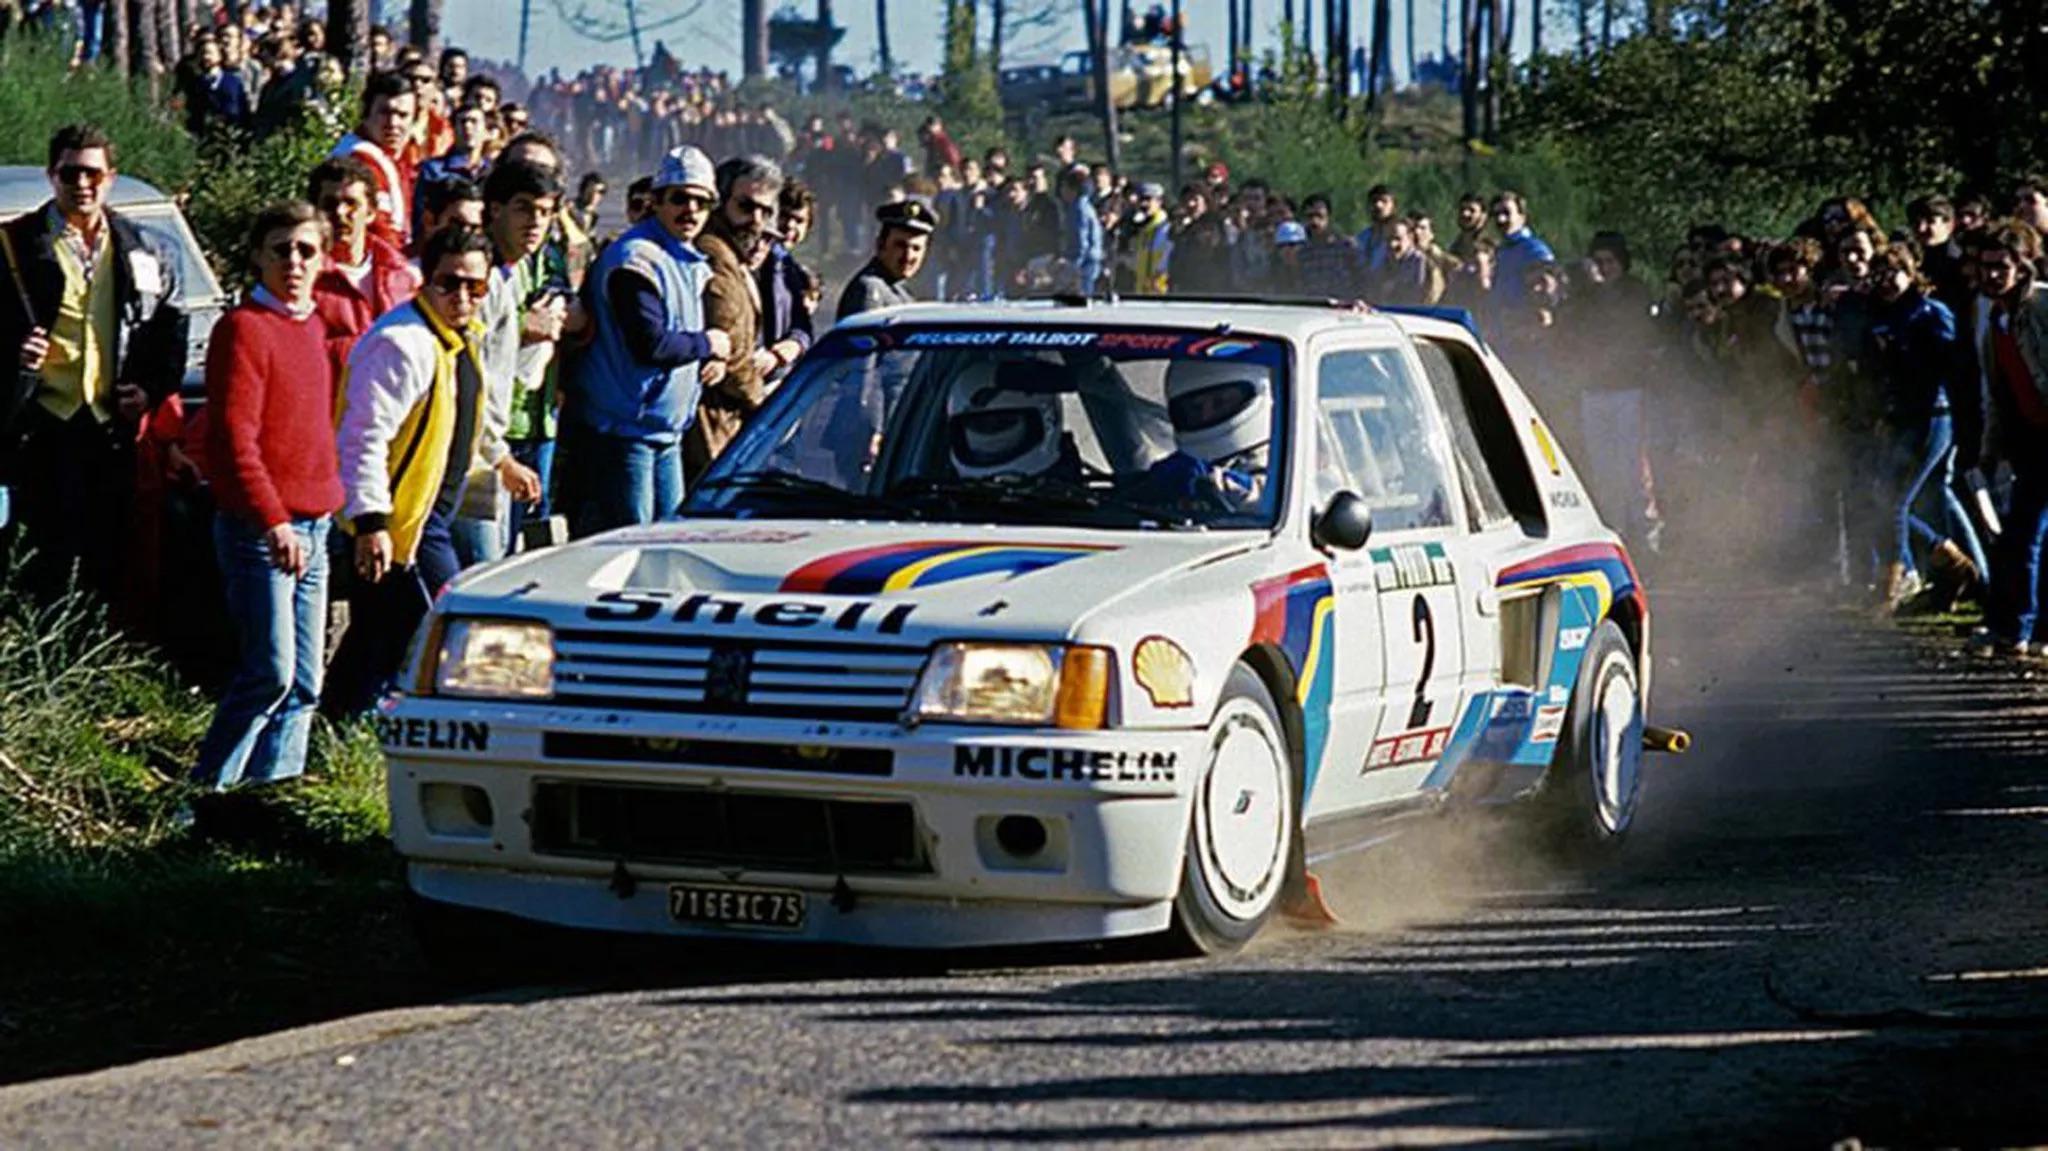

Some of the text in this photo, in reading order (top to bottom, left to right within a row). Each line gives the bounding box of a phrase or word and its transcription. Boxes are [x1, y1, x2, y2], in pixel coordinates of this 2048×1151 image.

[903, 331, 1181, 350] PEUGEOT TALBOT SPORT
[584, 591, 918, 635] Shell
[1406, 592, 1436, 730] 2
[953, 745, 1177, 782] MICHELIN
